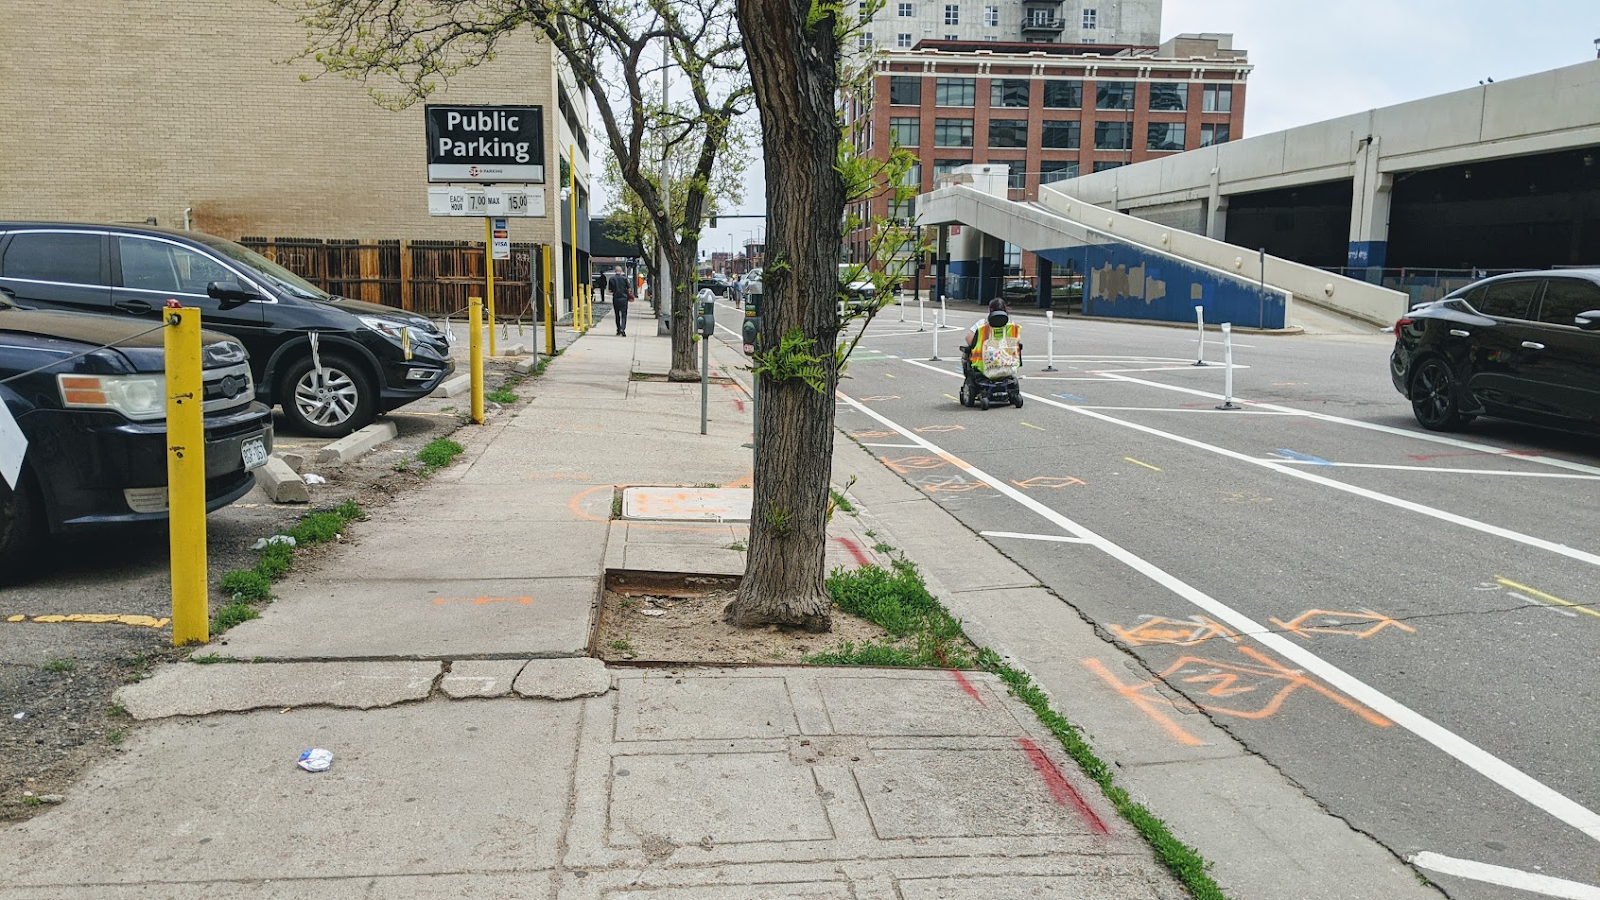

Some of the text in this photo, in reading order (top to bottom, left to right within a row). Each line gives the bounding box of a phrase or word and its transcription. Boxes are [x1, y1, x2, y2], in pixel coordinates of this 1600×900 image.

[447, 111, 519, 131] Public
[439, 137, 530, 163] Parking
[449, 195, 464, 203] EACH
[470, 196, 486, 210] 7.00
[487, 197, 501, 205] MAX
[509, 195, 528, 210] 15.00
[451, 203, 464, 211] HOUR
